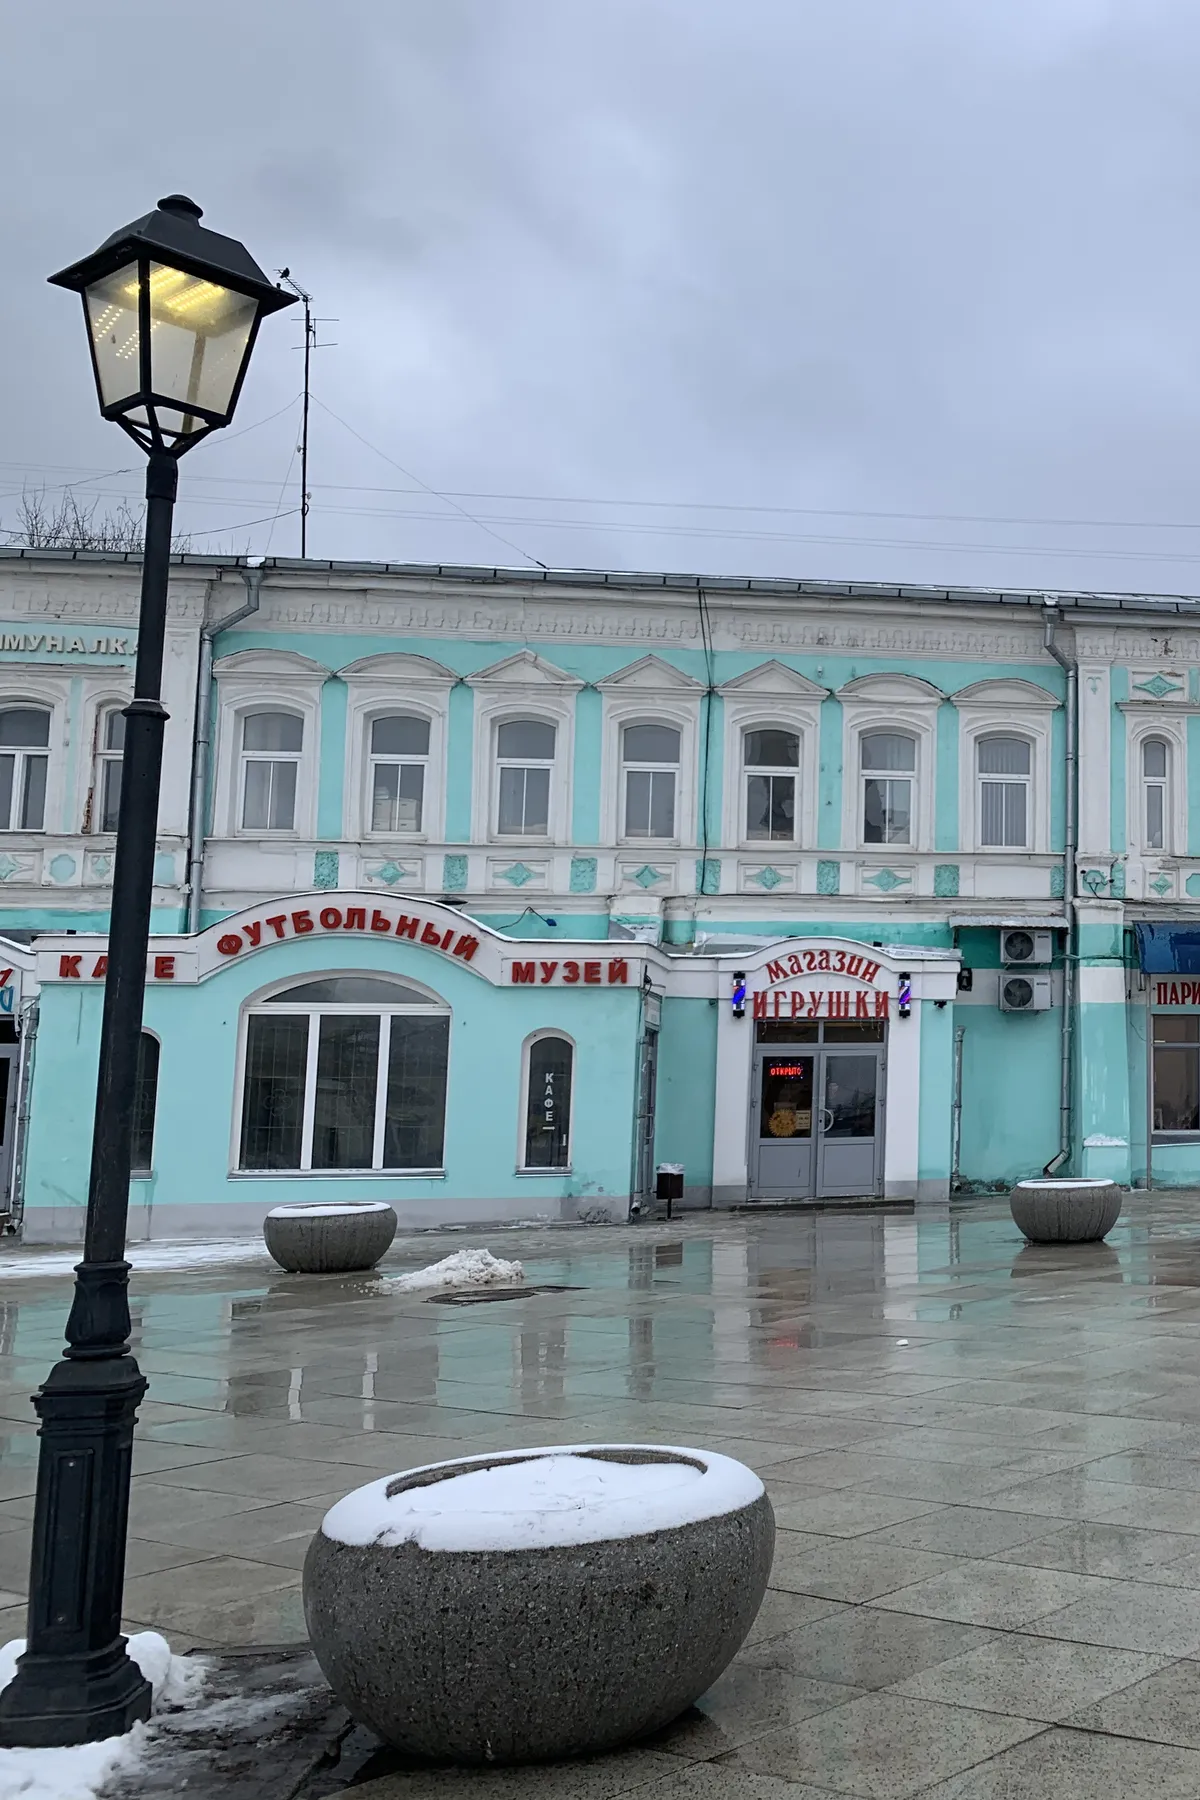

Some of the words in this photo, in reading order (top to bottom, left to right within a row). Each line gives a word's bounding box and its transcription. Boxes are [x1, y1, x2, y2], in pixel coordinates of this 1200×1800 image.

[0, 634, 138, 655] МУНАЛК
[59, 955, 176, 978] КАЕ
[216, 907, 480, 961] ФУТБОЛЬНЫЙ
[511, 957, 628, 984] МУЗЕЙ
[752, 991, 889, 1019] ИГРУШКИ
[770, 1067, 802, 1076] ОТКРЫТО
[544, 1072, 554, 1121] КАФЕ
